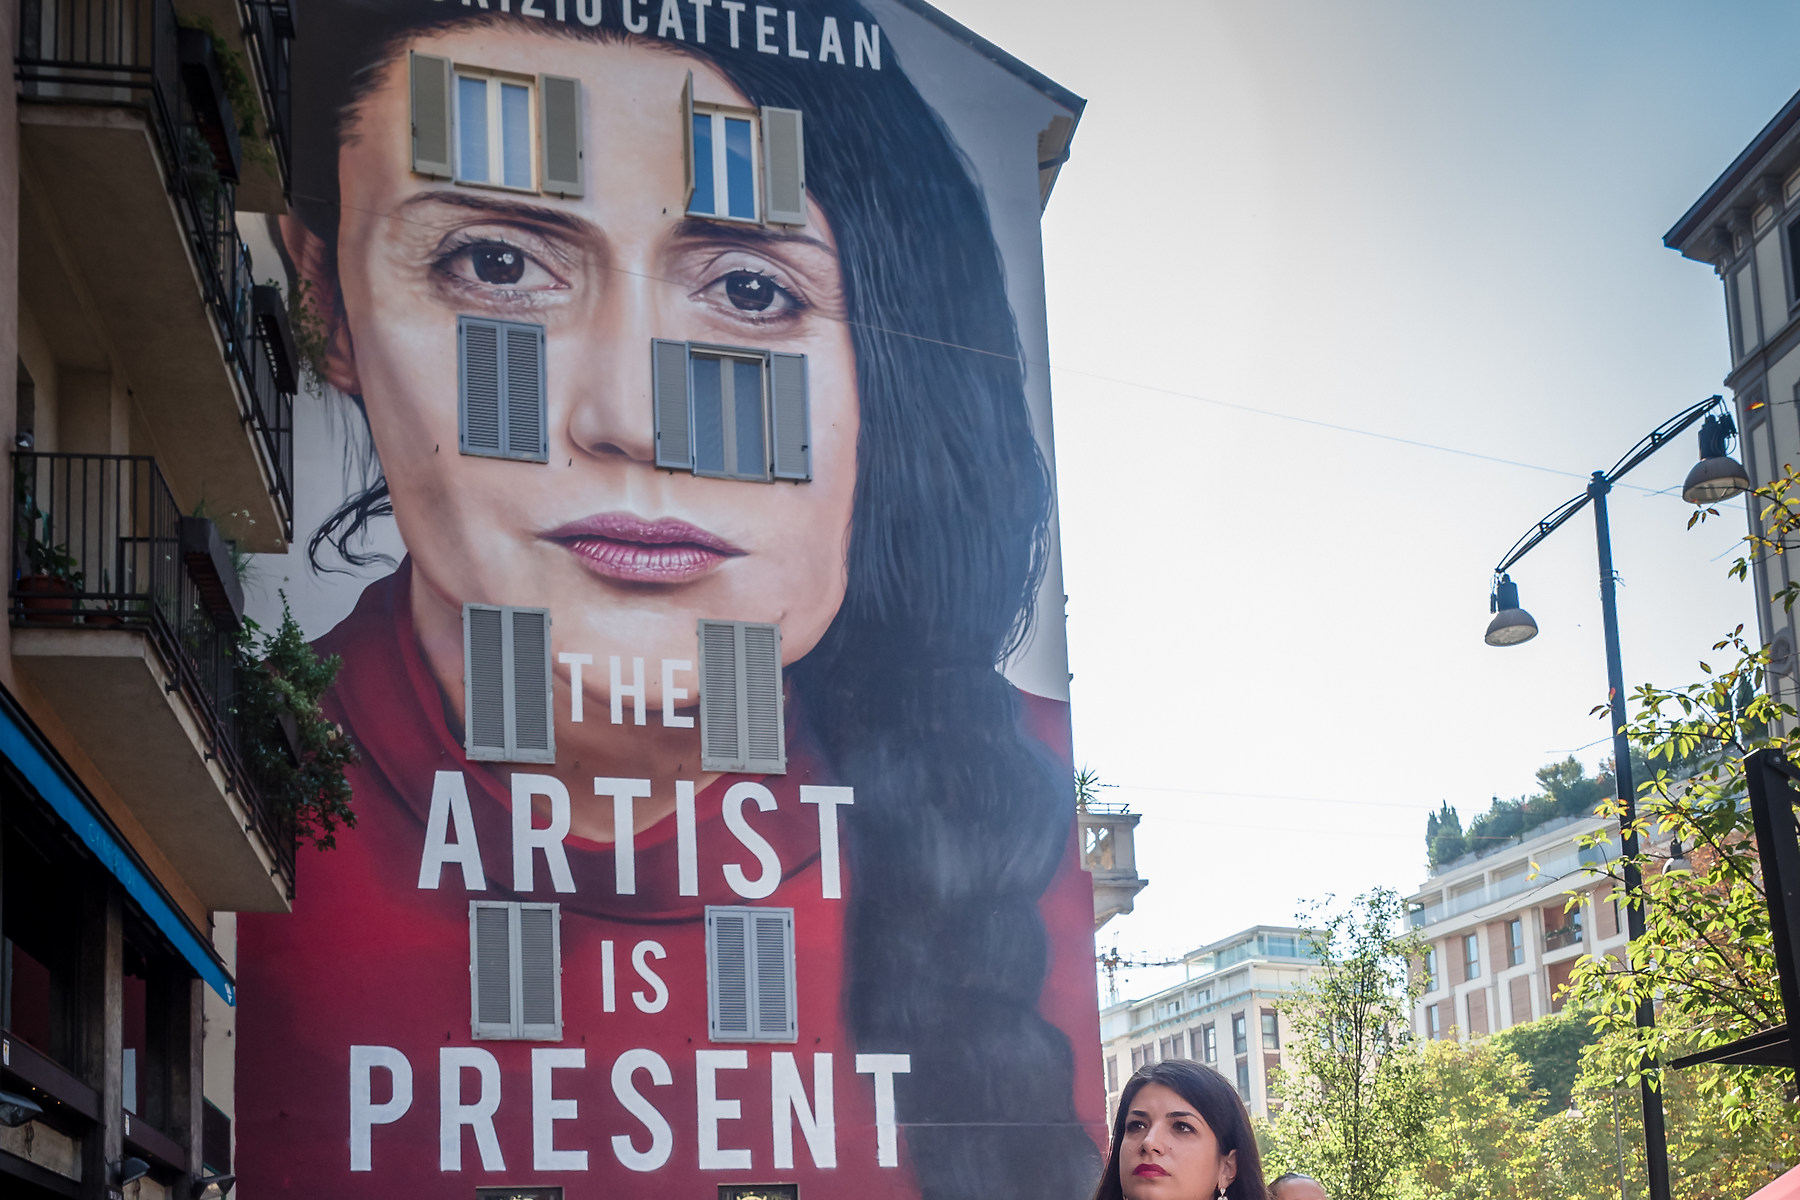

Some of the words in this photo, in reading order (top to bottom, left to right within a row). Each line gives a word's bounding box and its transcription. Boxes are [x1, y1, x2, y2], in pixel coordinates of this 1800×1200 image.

[622, 0, 881, 71] CATTELAN
[557, 652, 695, 728] THE
[417, 770, 855, 900] ARTIST
[601, 939, 669, 1014] IS
[349, 1044, 912, 1172] PRESENT
